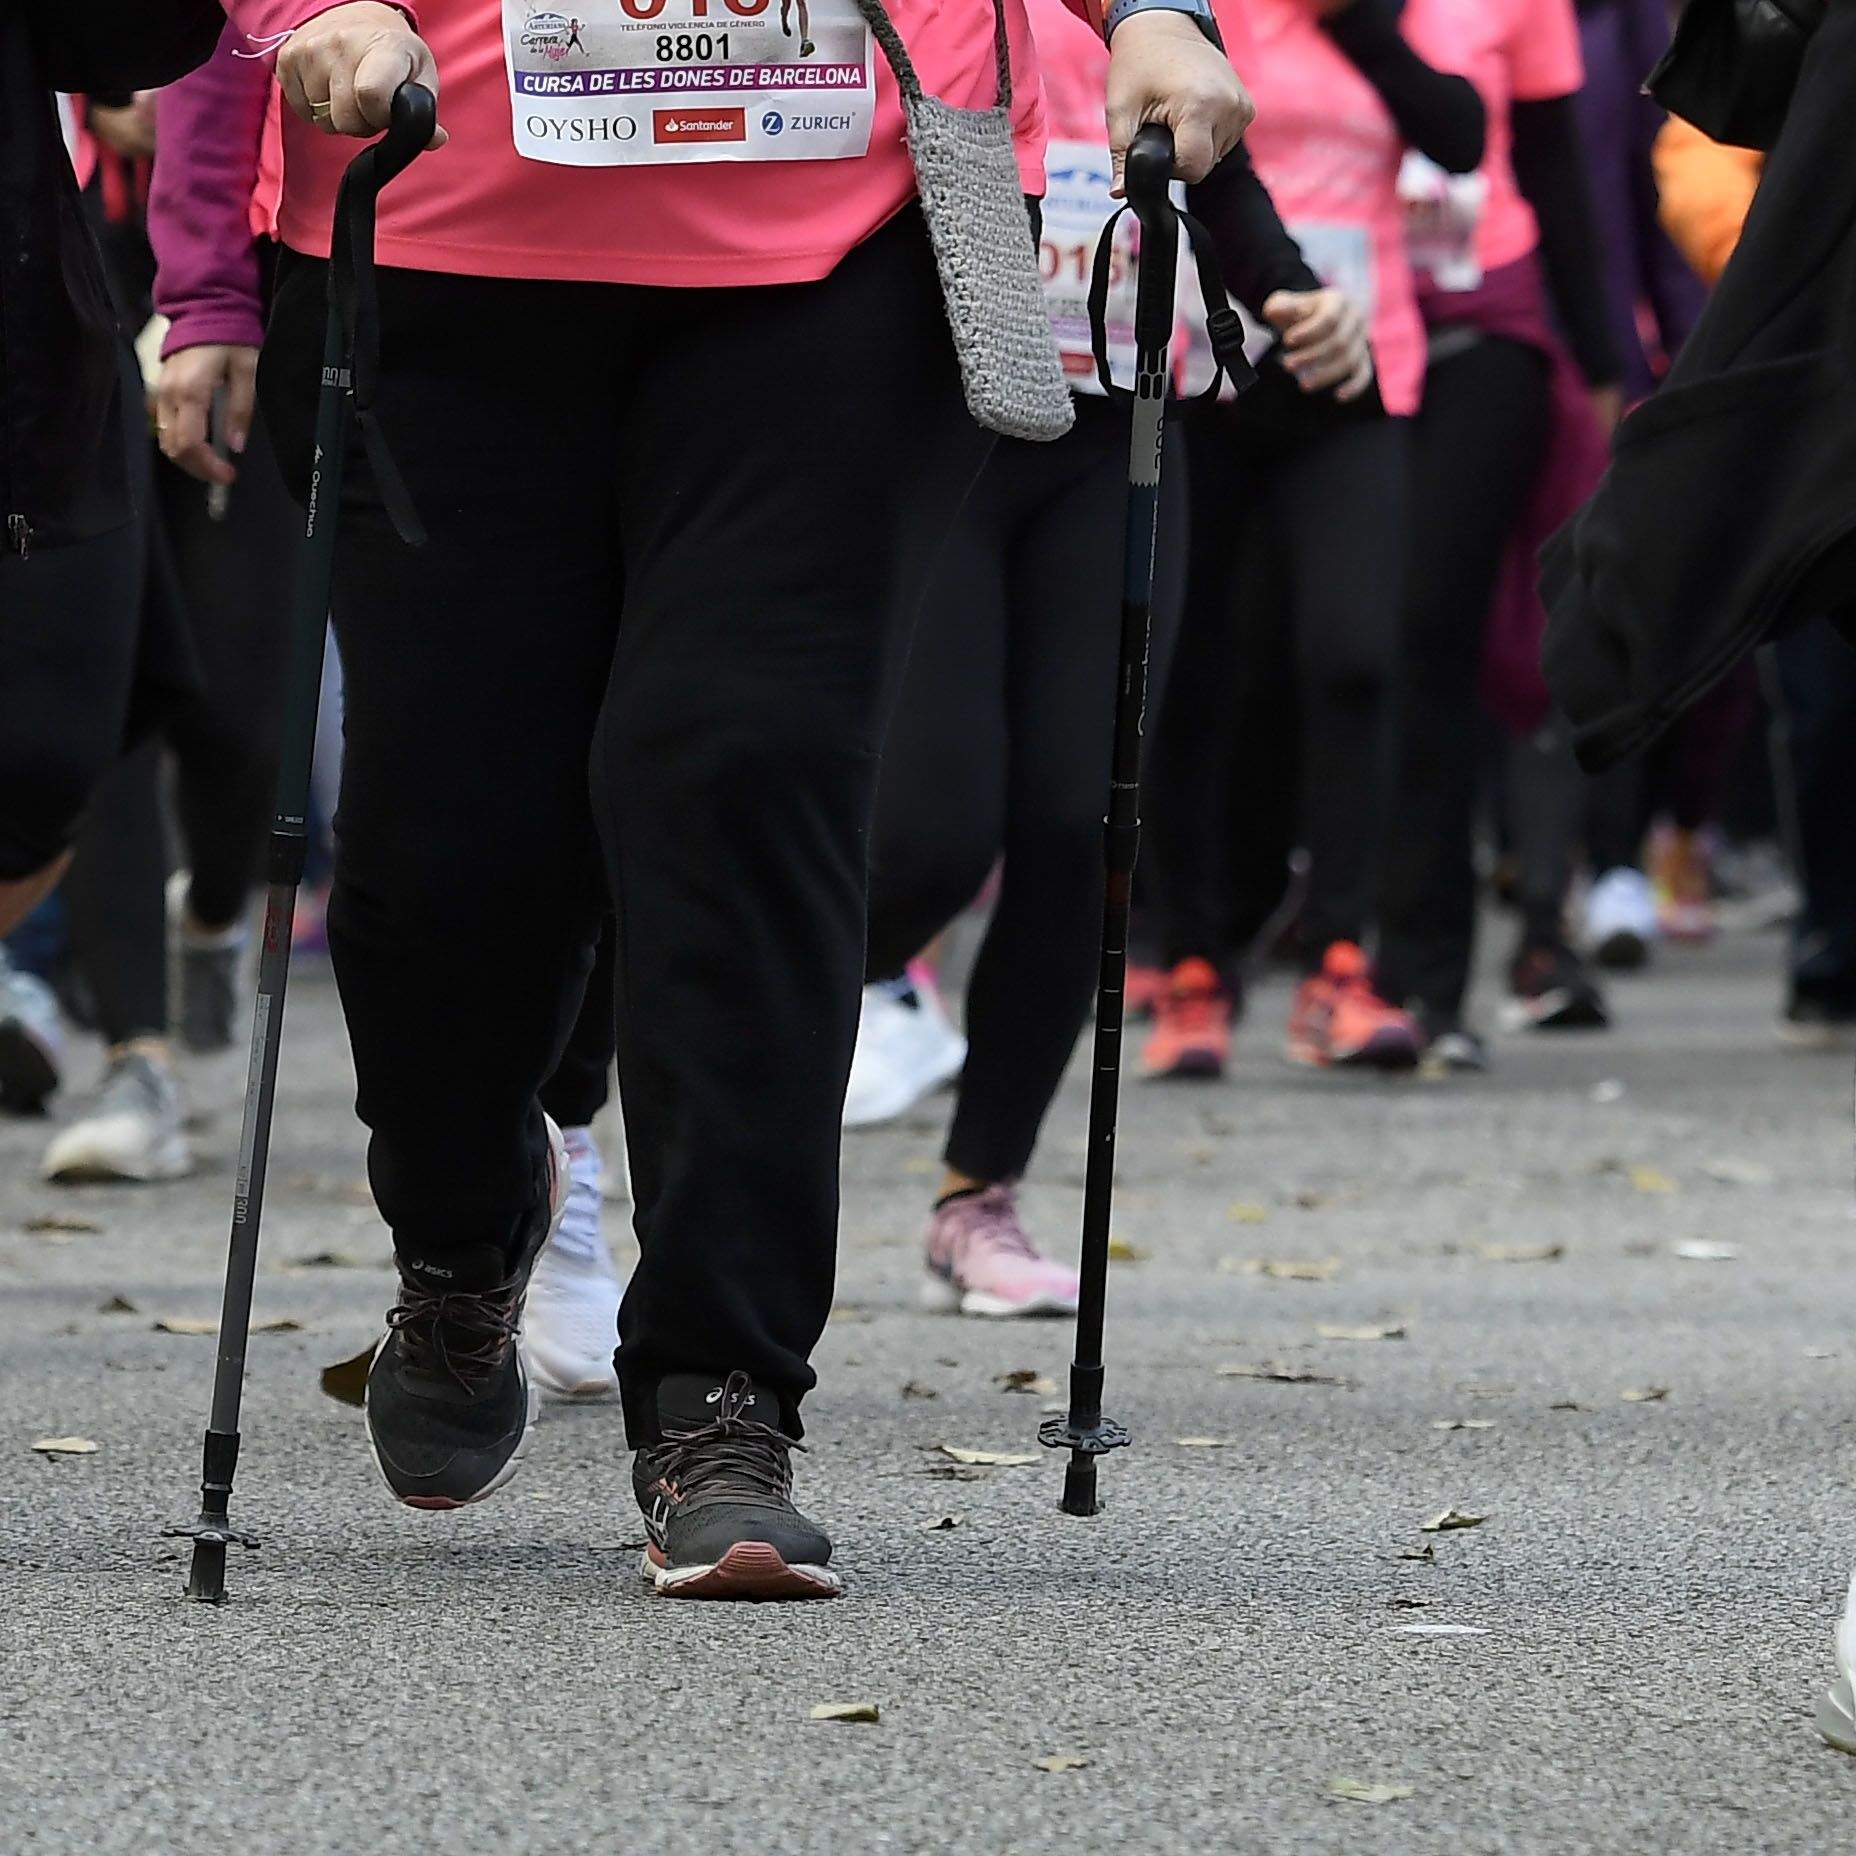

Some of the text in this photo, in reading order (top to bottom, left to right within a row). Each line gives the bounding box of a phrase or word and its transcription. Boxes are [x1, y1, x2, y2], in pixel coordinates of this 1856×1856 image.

[668, 21, 714, 30] VIOLENCIA
[656, 33, 729, 62] 8801
[523, 67, 862, 93] CURSA DE LES DONES DE BARCELONA
[526, 115, 637, 142] OYSHO
[679, 118, 734, 132] Santander
[790, 115, 851, 130] ZURICH
